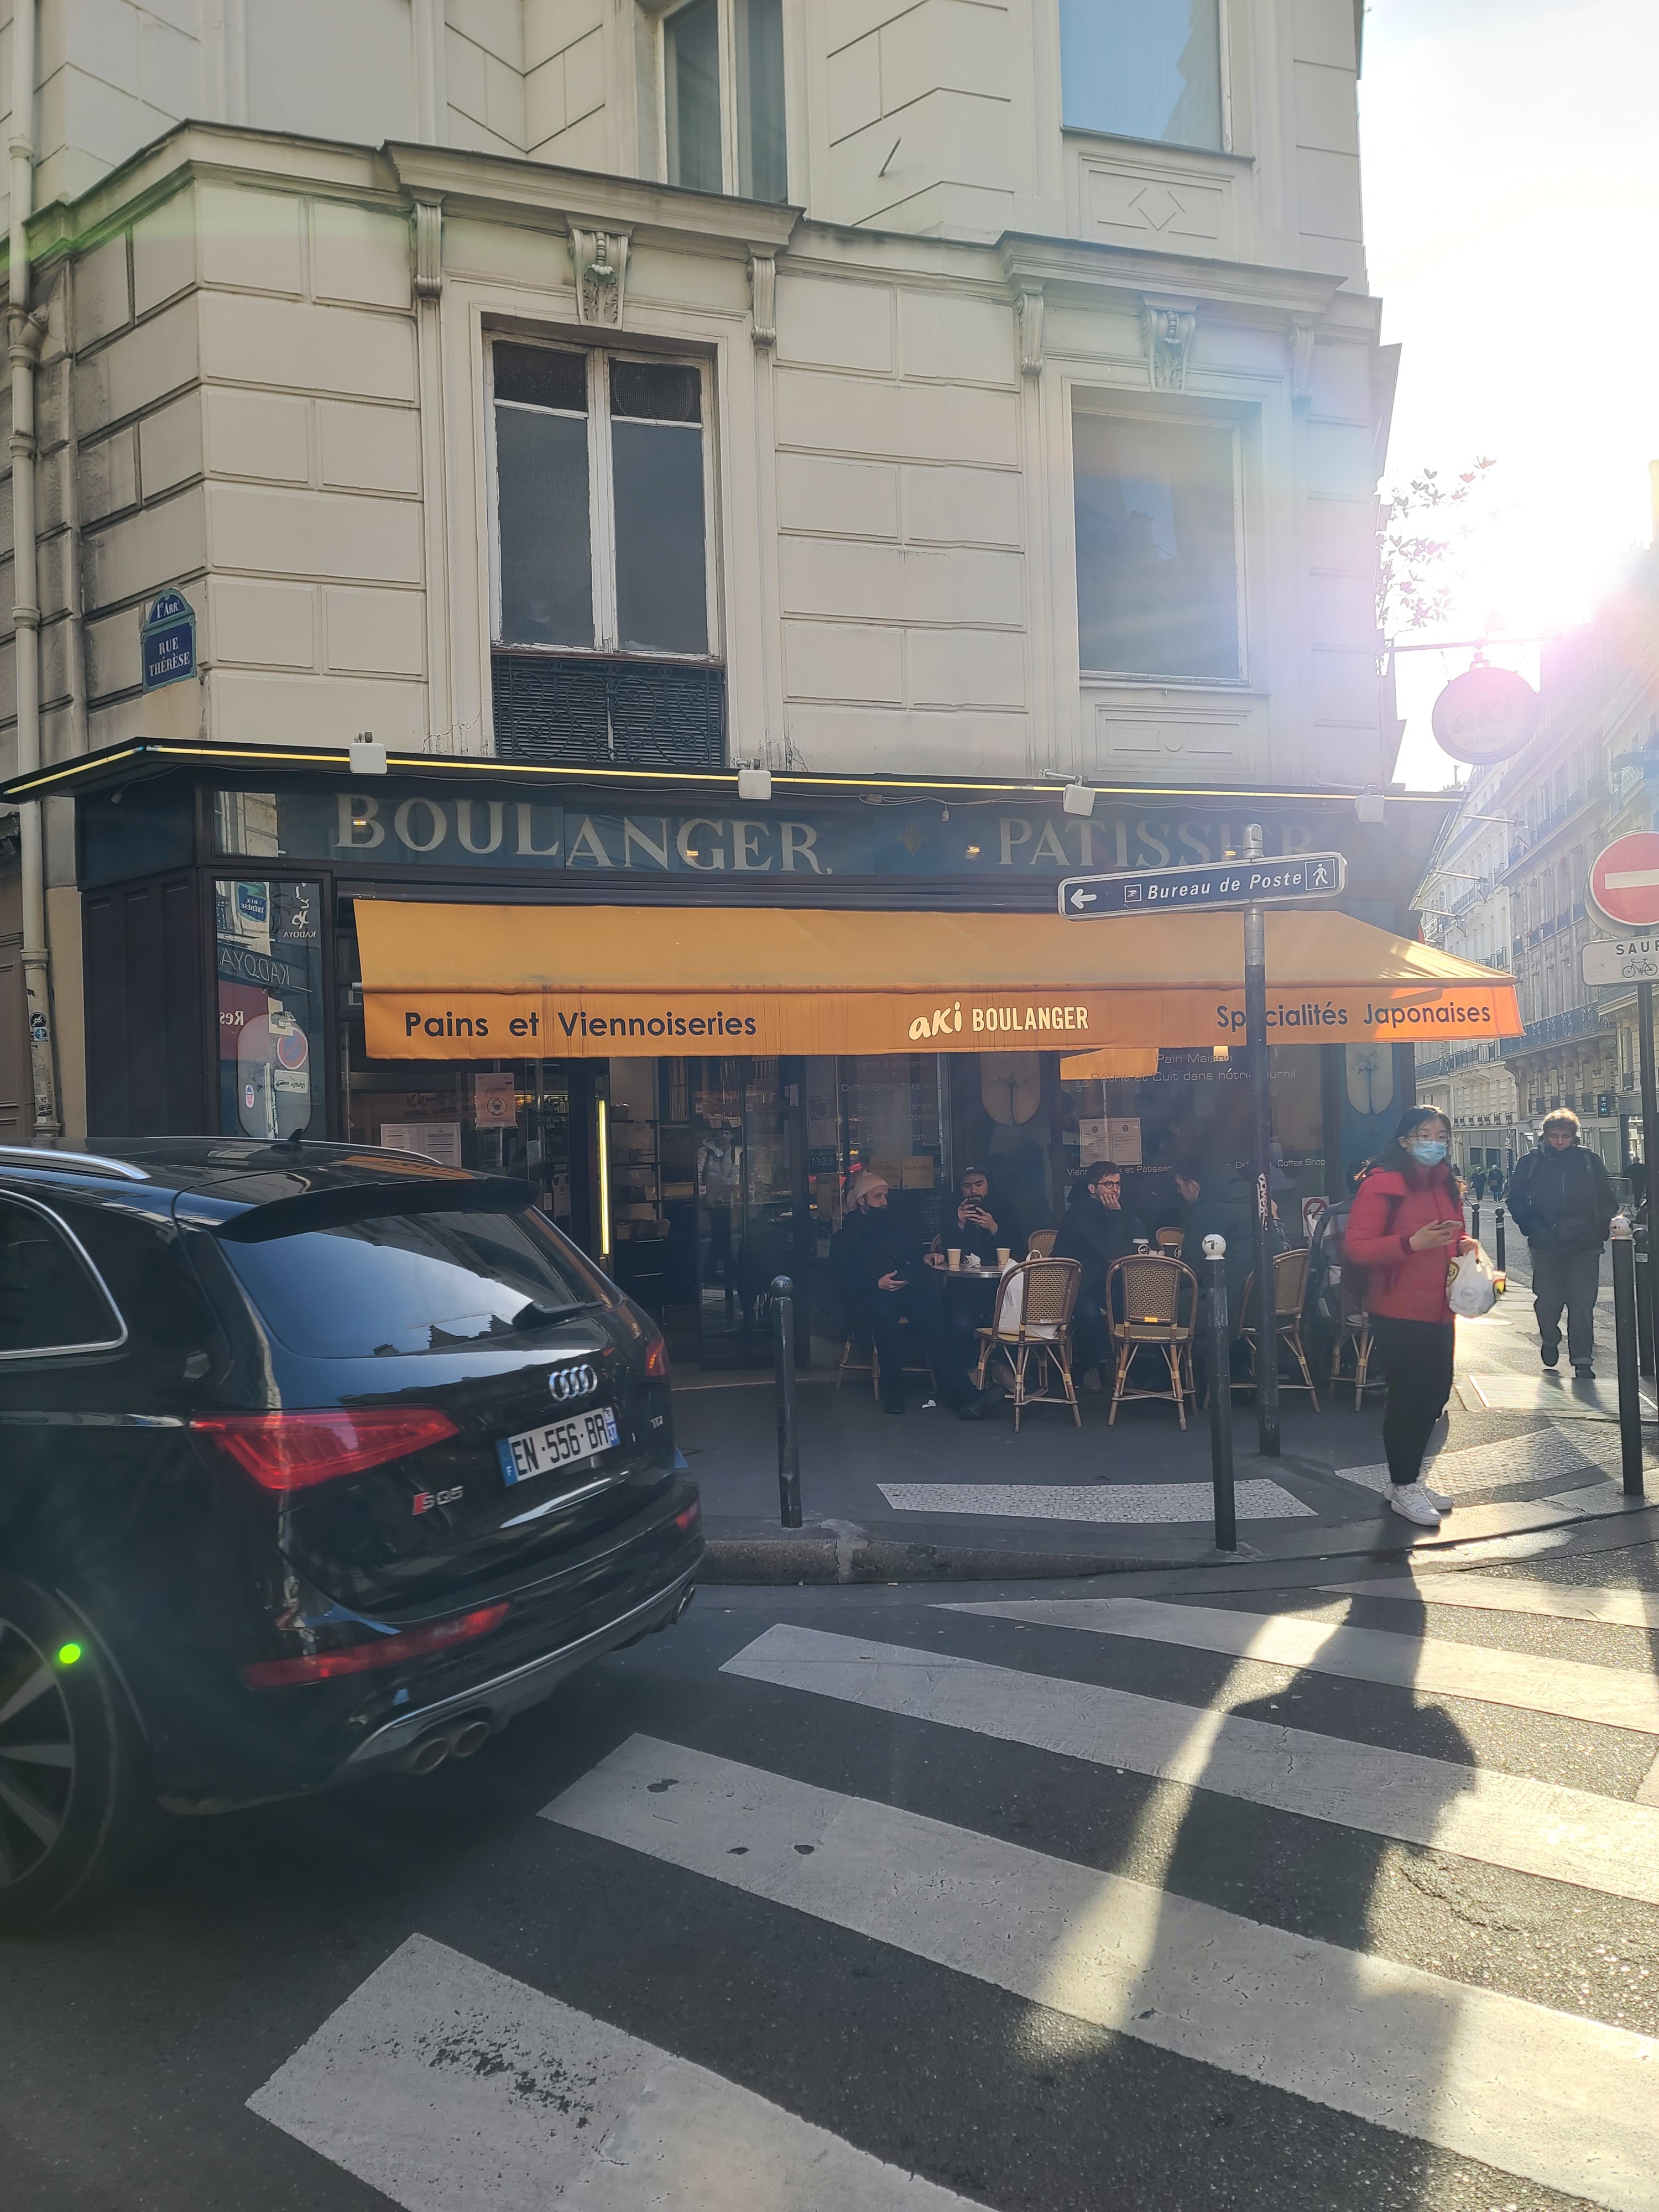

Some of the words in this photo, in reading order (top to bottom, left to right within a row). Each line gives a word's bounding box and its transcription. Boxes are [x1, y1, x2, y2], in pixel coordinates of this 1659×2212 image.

[159, 637, 179, 655] RUE
[149, 651, 190, 677] THÉRÈSE
[333, 793, 832, 875] BOULANGER
[998, 817, 1314, 868] PATISSIR
[1147, 881, 1211, 900] Bureau
[1219, 877, 1240, 893] de
[1249, 872, 1302, 890] Poste
[405, 1011, 489, 1037] Pains
[509, 1012, 539, 1037] et
[557, 1011, 757, 1036] Viennoiseries
[972, 1006, 1090, 1032] BOULANGER
[1217, 1001, 1348, 1032] Spcialités
[1363, 1001, 1491, 1029] Japonaises
[1157, 1053, 1182, 1064] Pain
[1187, 1053, 1233, 1063] Maison
[841, 1083, 870, 1092] Coffee
[1153, 1071, 1178, 1082] Cuit
[1183, 1071, 1213, 1081] dans
[1277, 1159, 1303, 1167] Coffee
[1305, 1158, 1326, 1167] Shop
